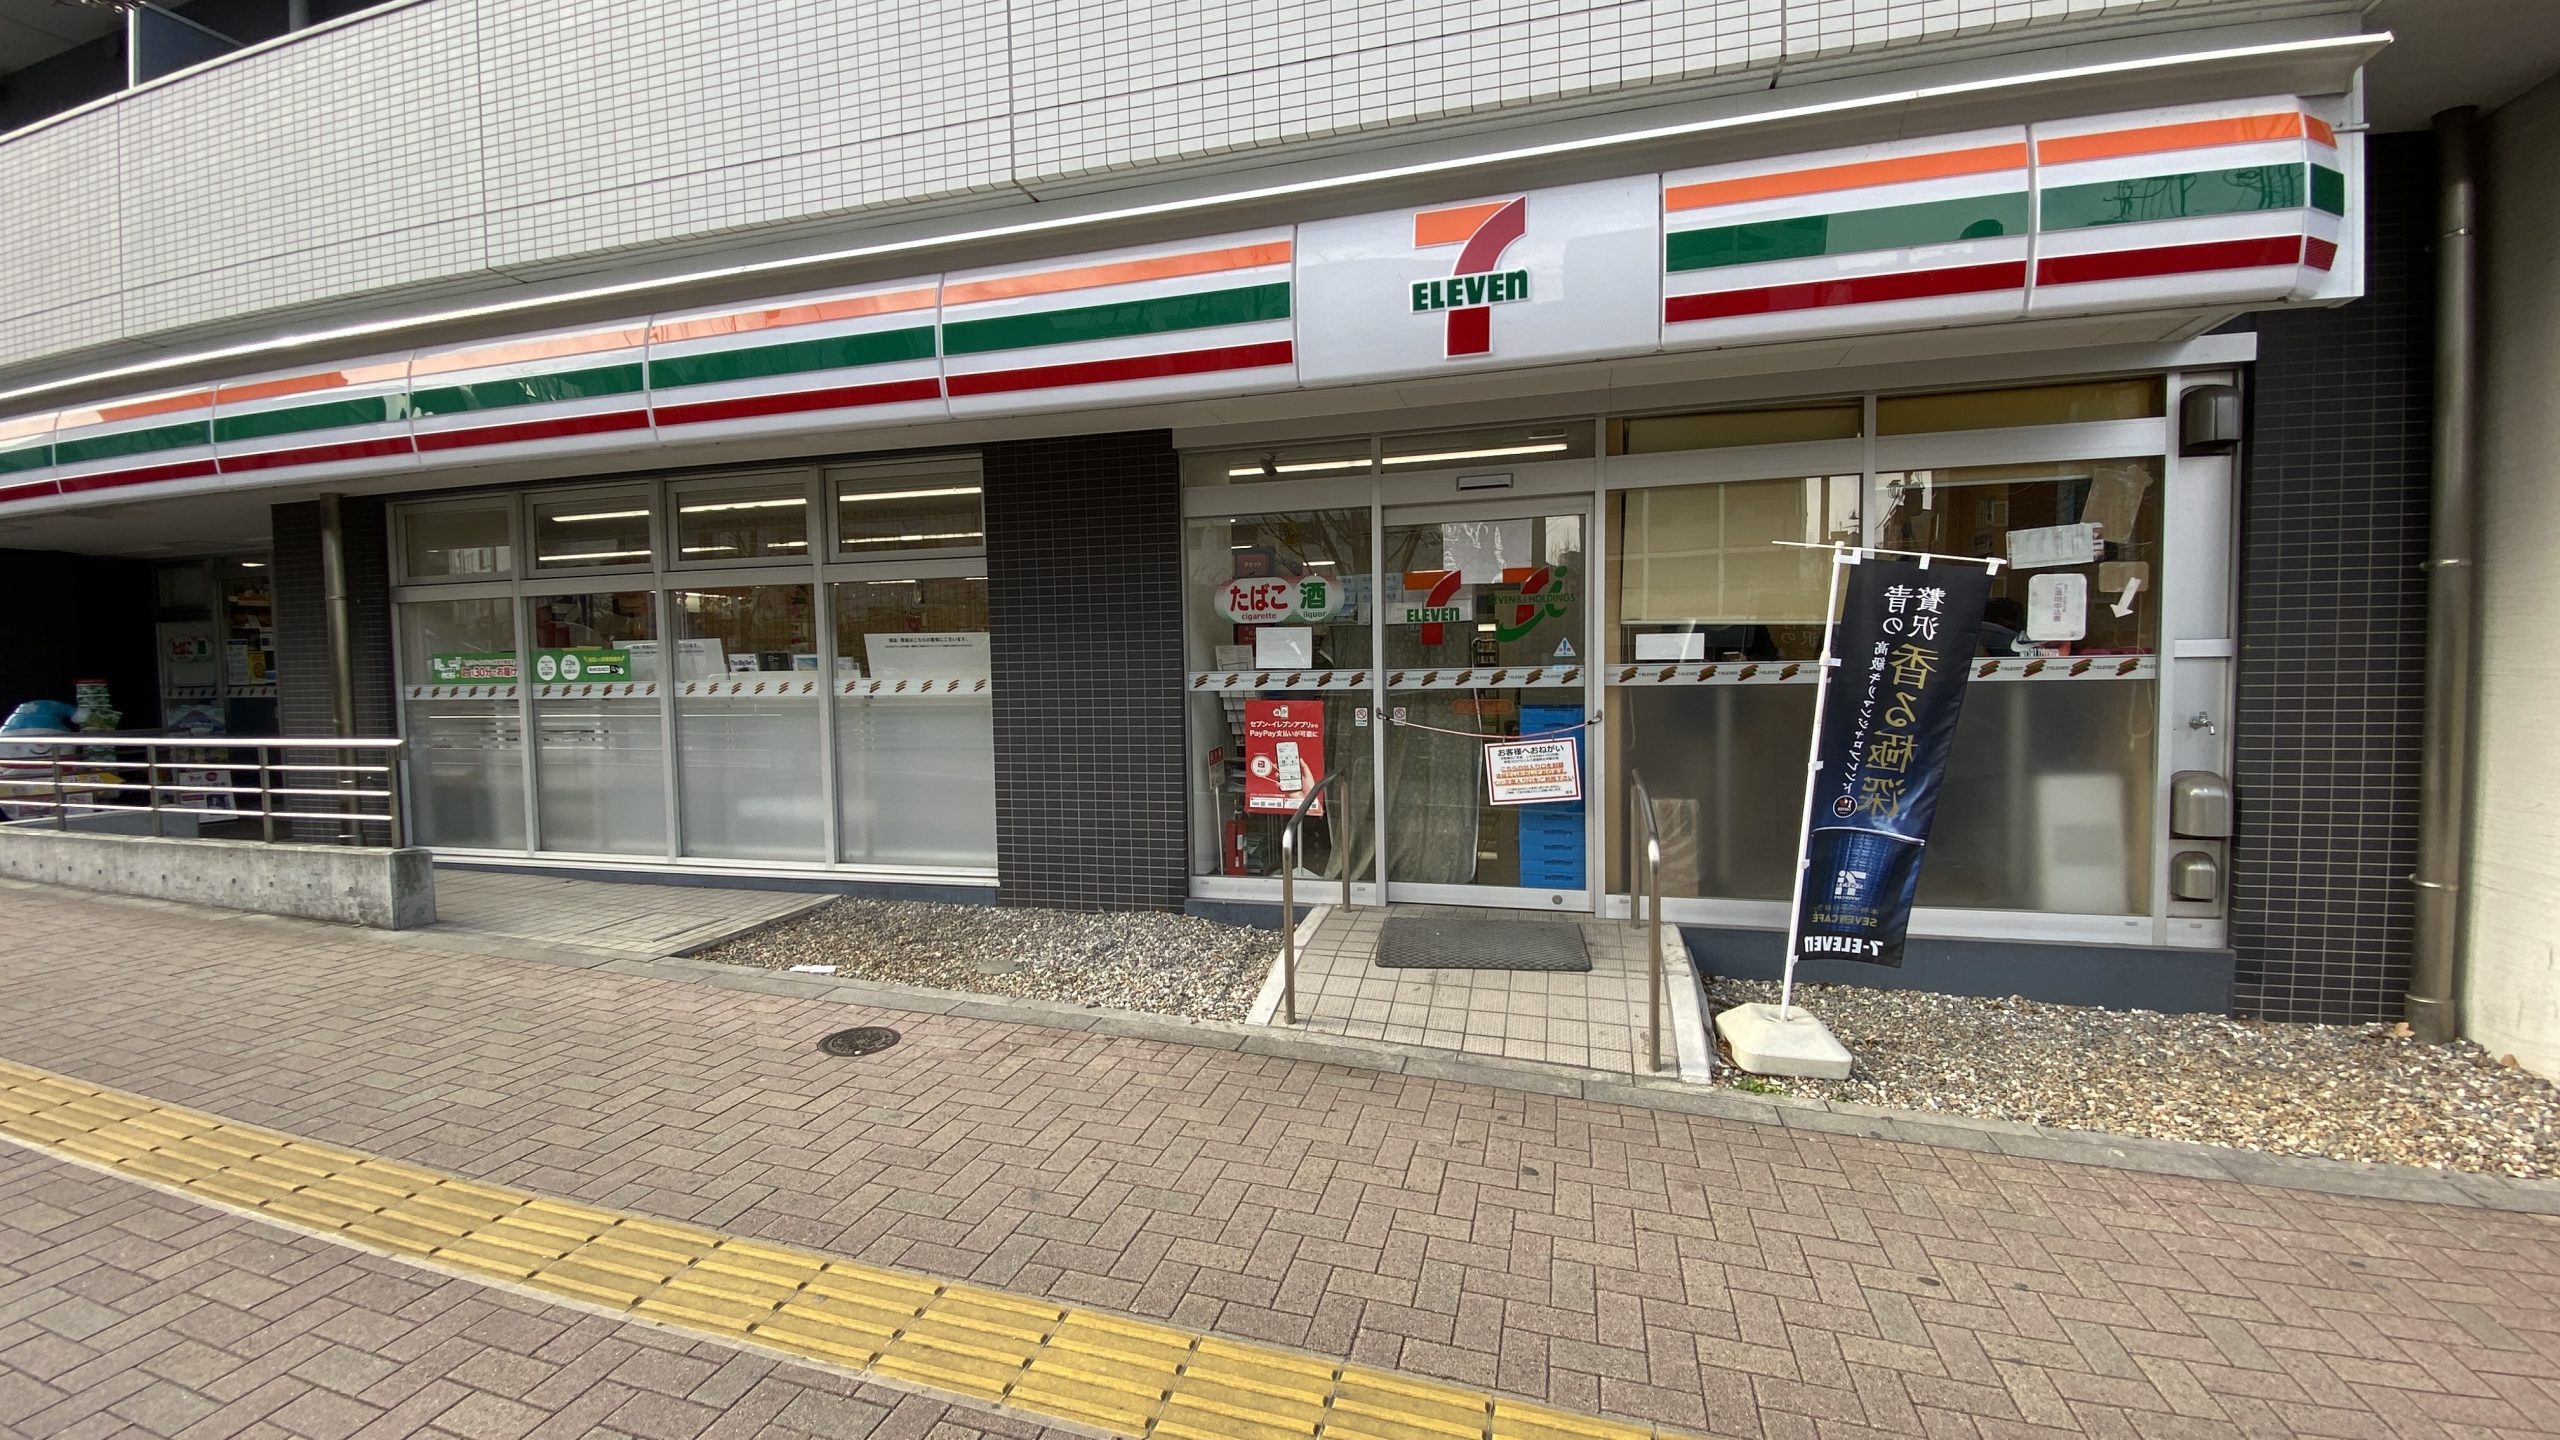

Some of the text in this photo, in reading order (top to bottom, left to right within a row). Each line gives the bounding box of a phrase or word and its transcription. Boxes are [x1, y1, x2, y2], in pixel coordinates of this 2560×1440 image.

[1229, 583, 1289, 612] たばこ
[1300, 581, 1326, 610] 酒
[1528, 593, 1576, 604] HOLDINGS
[1241, 612, 1277, 621] cigarette
[1302, 611, 1327, 619] liquor
[1249, 729, 1319, 738] PayPay支払いが可能に
[1497, 745, 1564, 757] お客様へおねがい
